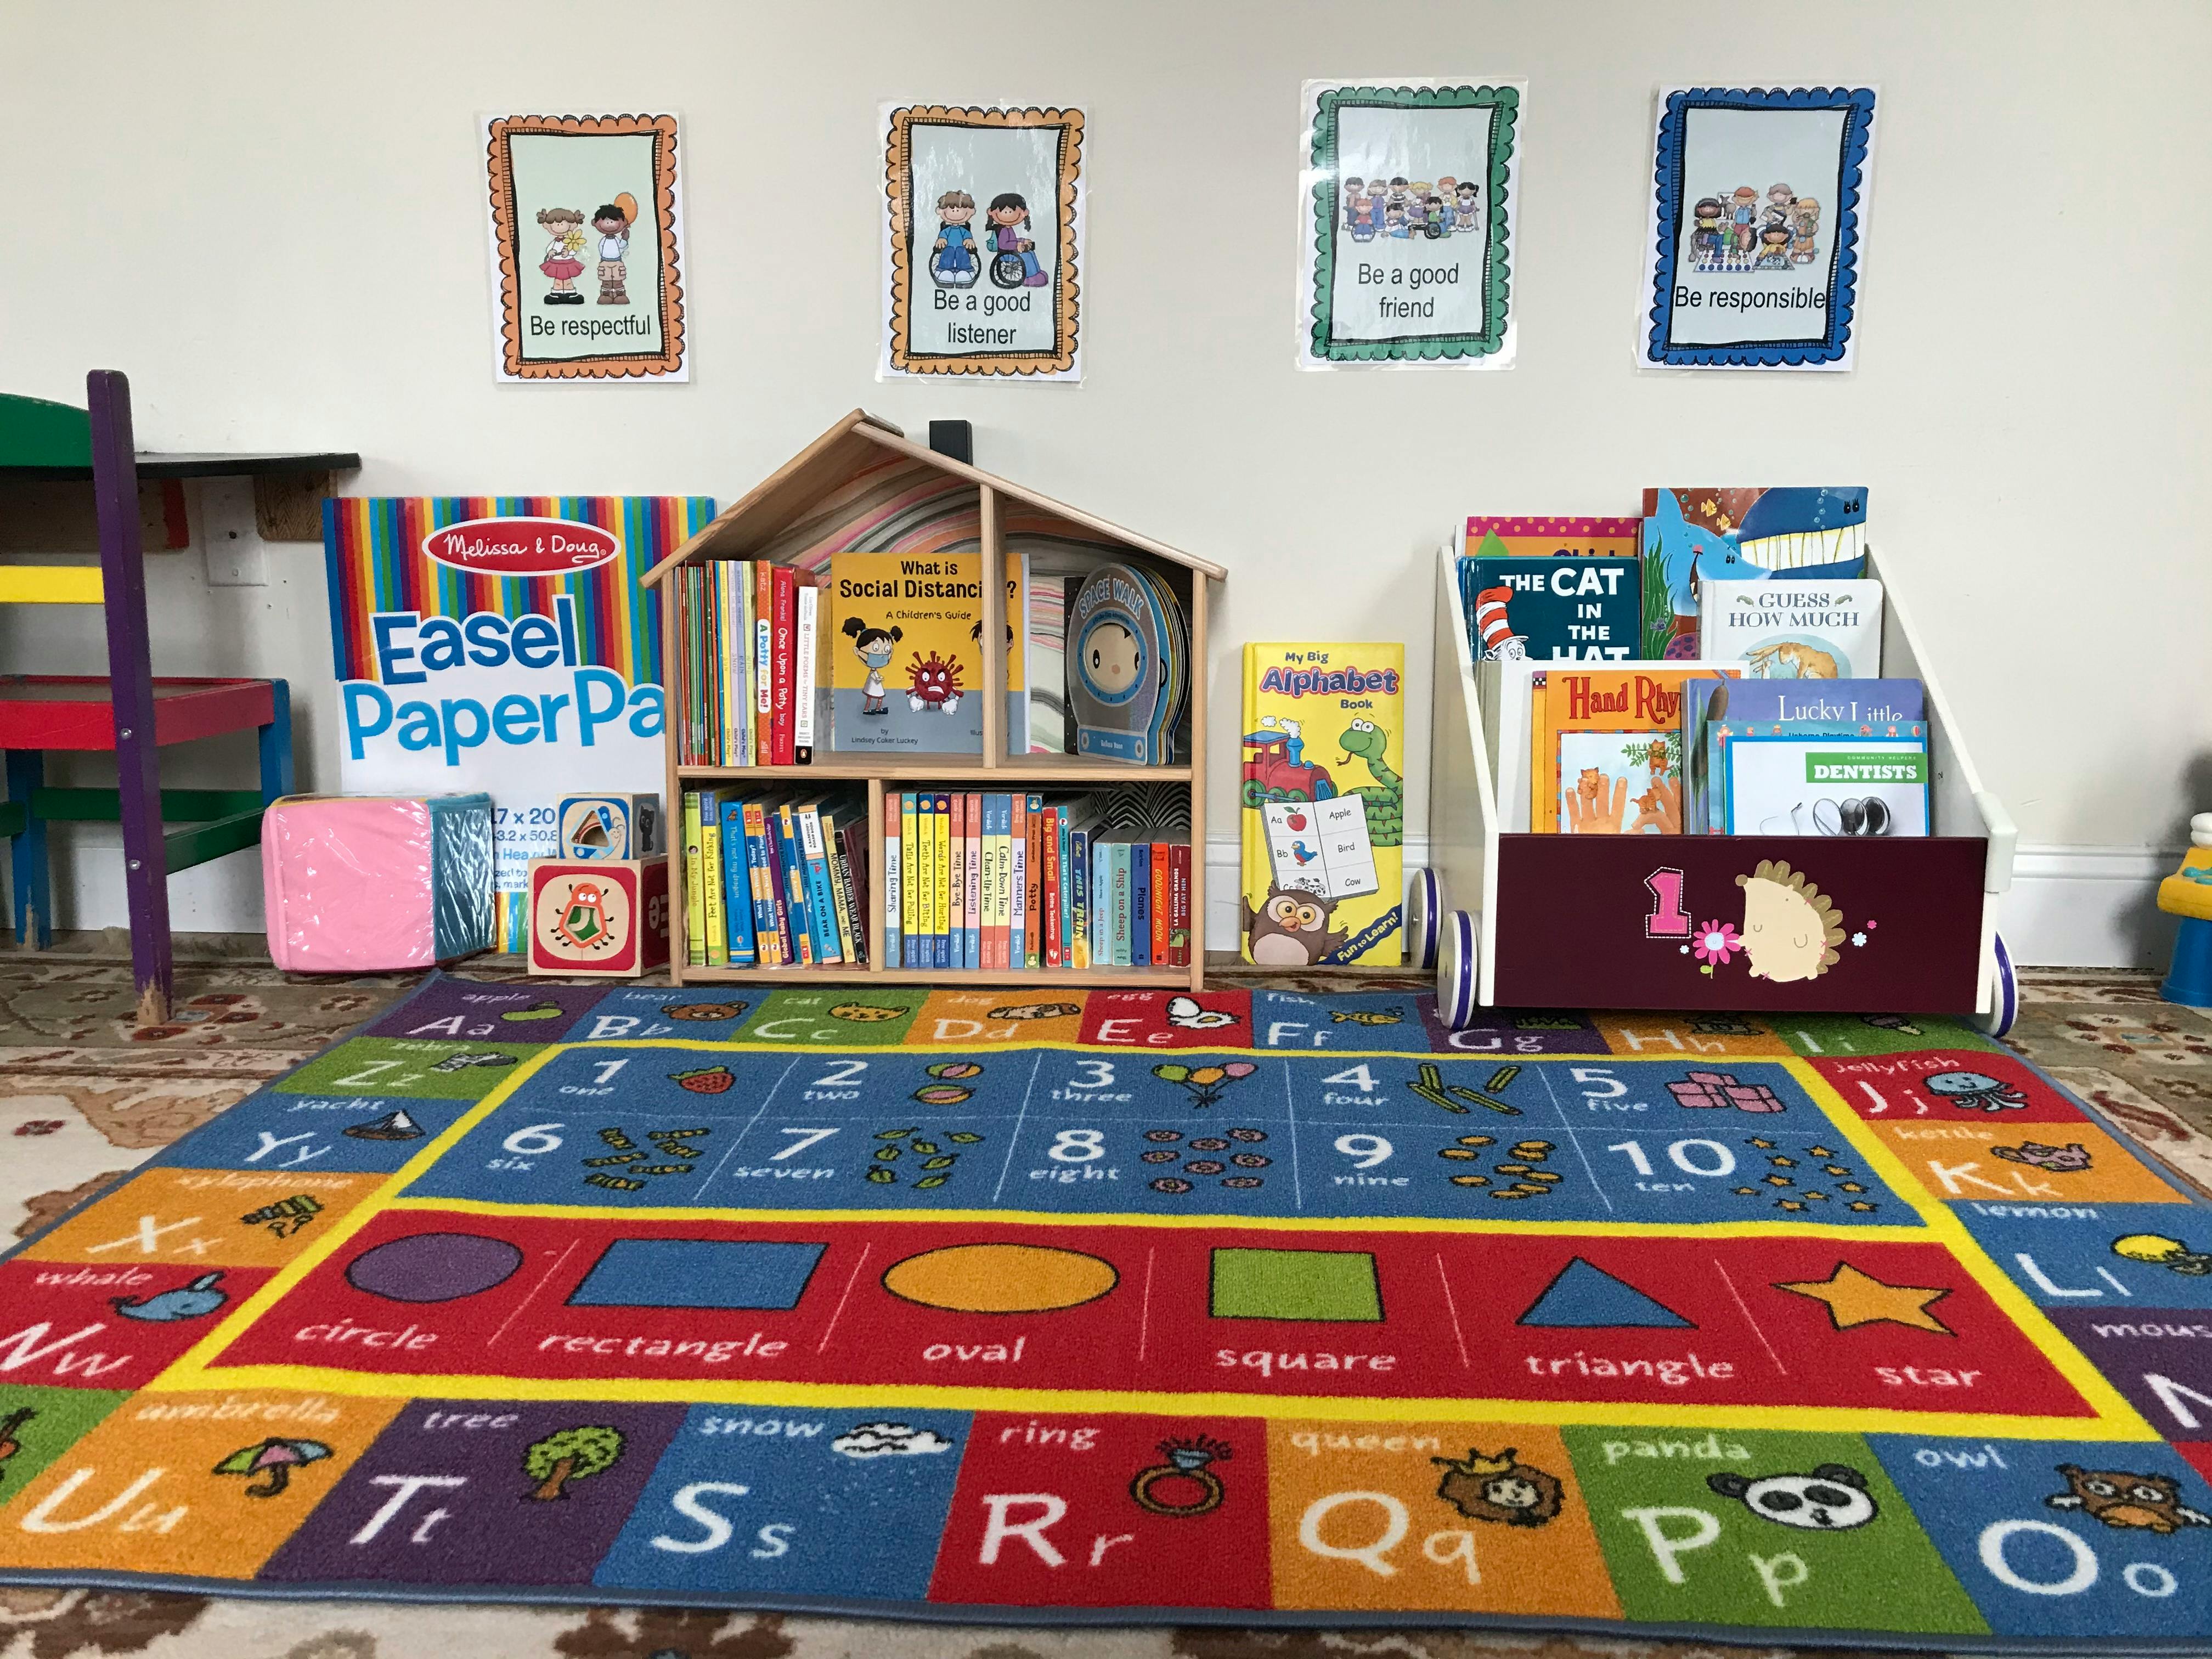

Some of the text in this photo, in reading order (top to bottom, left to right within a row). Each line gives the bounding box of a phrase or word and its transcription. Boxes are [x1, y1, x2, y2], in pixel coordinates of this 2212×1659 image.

[1358, 262, 1459, 291] Be a good
[934, 290, 1031, 320] Be a good
[1379, 297, 1435, 318] friend
[1676, 286, 1825, 314] Be responsible
[531, 314, 651, 342] Be respectful
[947, 323, 1017, 345] listener
[443, 534, 599, 563] Melissa & Doug
[901, 561, 958, 575] What is
[840, 579, 1017, 599] Social Distanci?
[1499, 567, 1624, 596] THE CAT
[1079, 578, 1144, 620] SPACE WALK
[1577, 603, 1602, 619] IN
[1759, 591, 1830, 608] GUESS
[886, 610, 972, 620] A Children's Guide
[1729, 612, 1859, 628] HOW MUCH
[374, 597, 578, 685] Easel
[778, 627, 788, 650] Once
[1568, 625, 1610, 641] THE
[759, 635, 769, 666] Potty
[1285, 651, 1329, 663] My Big
[1553, 646, 1629, 660] HAT
[777, 653, 787, 675] Upon
[760, 669, 769, 686] for
[1260, 665, 1400, 697] Alphabet
[760, 689, 769, 708] Me!
[775, 687, 788, 710] Potty
[1341, 698, 1373, 709] Book
[1561, 676, 1681, 724] Hand Rhy
[1779, 695, 1903, 722] Lucky Little
[342, 669, 664, 766] PaperPa
[778, 713, 787, 726] boy
[1814, 764, 1917, 780] DENTISTS
[514, 812, 524, 825] x
[529, 808, 556, 825] 20
[1045, 817, 1056, 833] Big
[1271, 815, 1283, 824] Aa
[1329, 807, 1352, 821] Apple
[705, 833, 715, 859] Kicking
[1046, 835, 1056, 853] and
[1277, 849, 1288, 858] Bb
[1338, 842, 1356, 853] Bird
[707, 874, 715, 885] Not
[952, 851, 962, 907] Bye-Bye Time
[1047, 856, 1056, 881] Small
[1116, 867, 1127, 889] Ship
[707, 888, 716, 900] Are
[888, 855, 898, 912] Sharing Time
[968, 851, 978, 914] Listening Time
[984, 852, 994, 912] Clean-Up Time
[998, 846, 1009, 917] Calm-Down Time
[1013, 851, 1024, 916] Manners Time
[1345, 877, 1361, 887] Cow
[1029, 883, 1037, 911] Potty
[1074, 869, 1084, 940] THIS TRAIN
[1118, 899, 1125, 910] on
[1137, 887, 1146, 920] Planes
[1155, 869, 1164, 943] GOODNIGHT MOON
[1645, 867, 1691, 938] 1
[708, 903, 716, 918] Feet
[1116, 913, 1127, 941] Sheep
[1336, 911, 1400, 961] Fun to Learn!
[593, 1058, 629, 1084] 1
[811, 1061, 870, 1086] 2
[1070, 1060, 1116, 1088] 3
[1323, 1063, 1381, 1093] 4
[1570, 1068, 1629, 1098] 5
[558, 1084, 614, 1096] one
[804, 1090, 860, 1101] two
[1052, 1090, 1132, 1103] three
[1324, 1094, 1390, 1106] four
[503, 1123, 566, 1154] 6
[770, 1127, 841, 1161] 7
[1048, 1129, 1106, 1163] 8
[1894, 1127, 1995, 1142] kettle
[486, 1157, 536, 1171] six
[1334, 1133, 1395, 1170] 9
[1608, 1138, 1736, 1177] 10
[734, 1168, 836, 1180] seven
[1030, 1167, 1121, 1183] eight
[1334, 1175, 1410, 1187] nine
[1635, 1180, 1696, 1193] ten
[1972, 1202, 2098, 1220] lemon
[36, 1266, 154, 1286] whale
[294, 1318, 439, 1351] circle
[2091, 1323, 2212, 1339] mous
[538, 1330, 789, 1363] rectangle
[923, 1335, 1025, 1363] oval
[1216, 1347, 1397, 1376] square
[1524, 1351, 1735, 1386] triangle
[1872, 1365, 1983, 1389] star
[135, 1396, 341, 1423] umbrella
[424, 1409, 520, 1431] tree
[697, 1414, 825, 1439] snow
[1000, 1421, 1101, 1451] ring
[1291, 1430, 1442, 1455] queen
[1601, 1435, 1752, 1464] panda
[1914, 1444, 2008, 1470] owl
